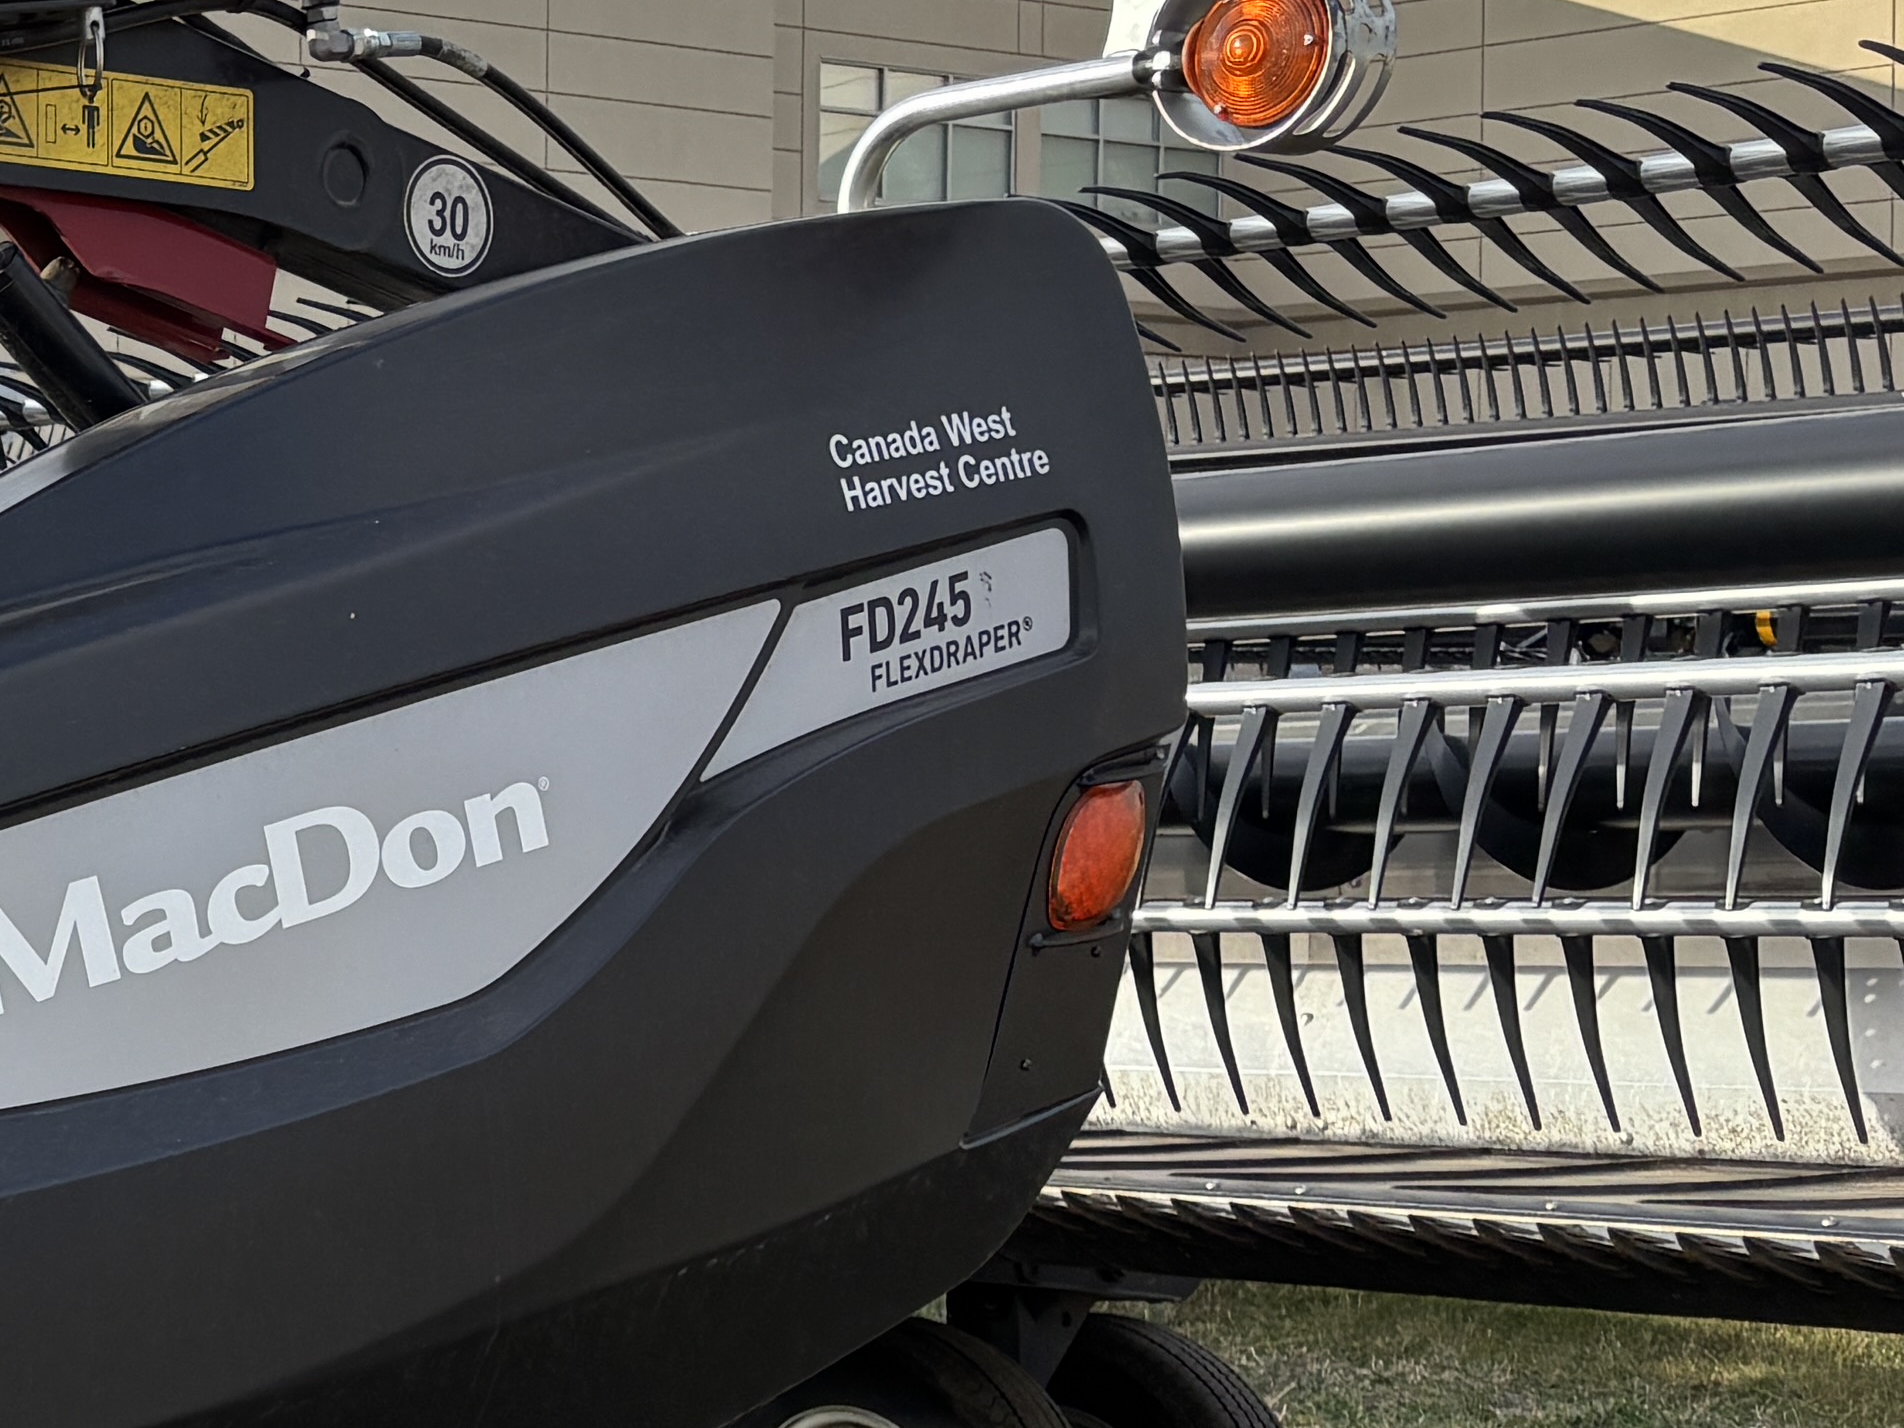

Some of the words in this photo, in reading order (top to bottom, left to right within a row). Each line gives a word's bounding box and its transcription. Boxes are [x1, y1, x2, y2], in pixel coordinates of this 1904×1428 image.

[427, 191, 469, 242] 30
[429, 238, 465, 261] km/h
[829, 420, 941, 468] Canada
[941, 405, 1017, 447] West
[839, 460, 955, 512] Harvest
[957, 447, 1050, 489] Centre
[840, 570, 972, 662] FD245
